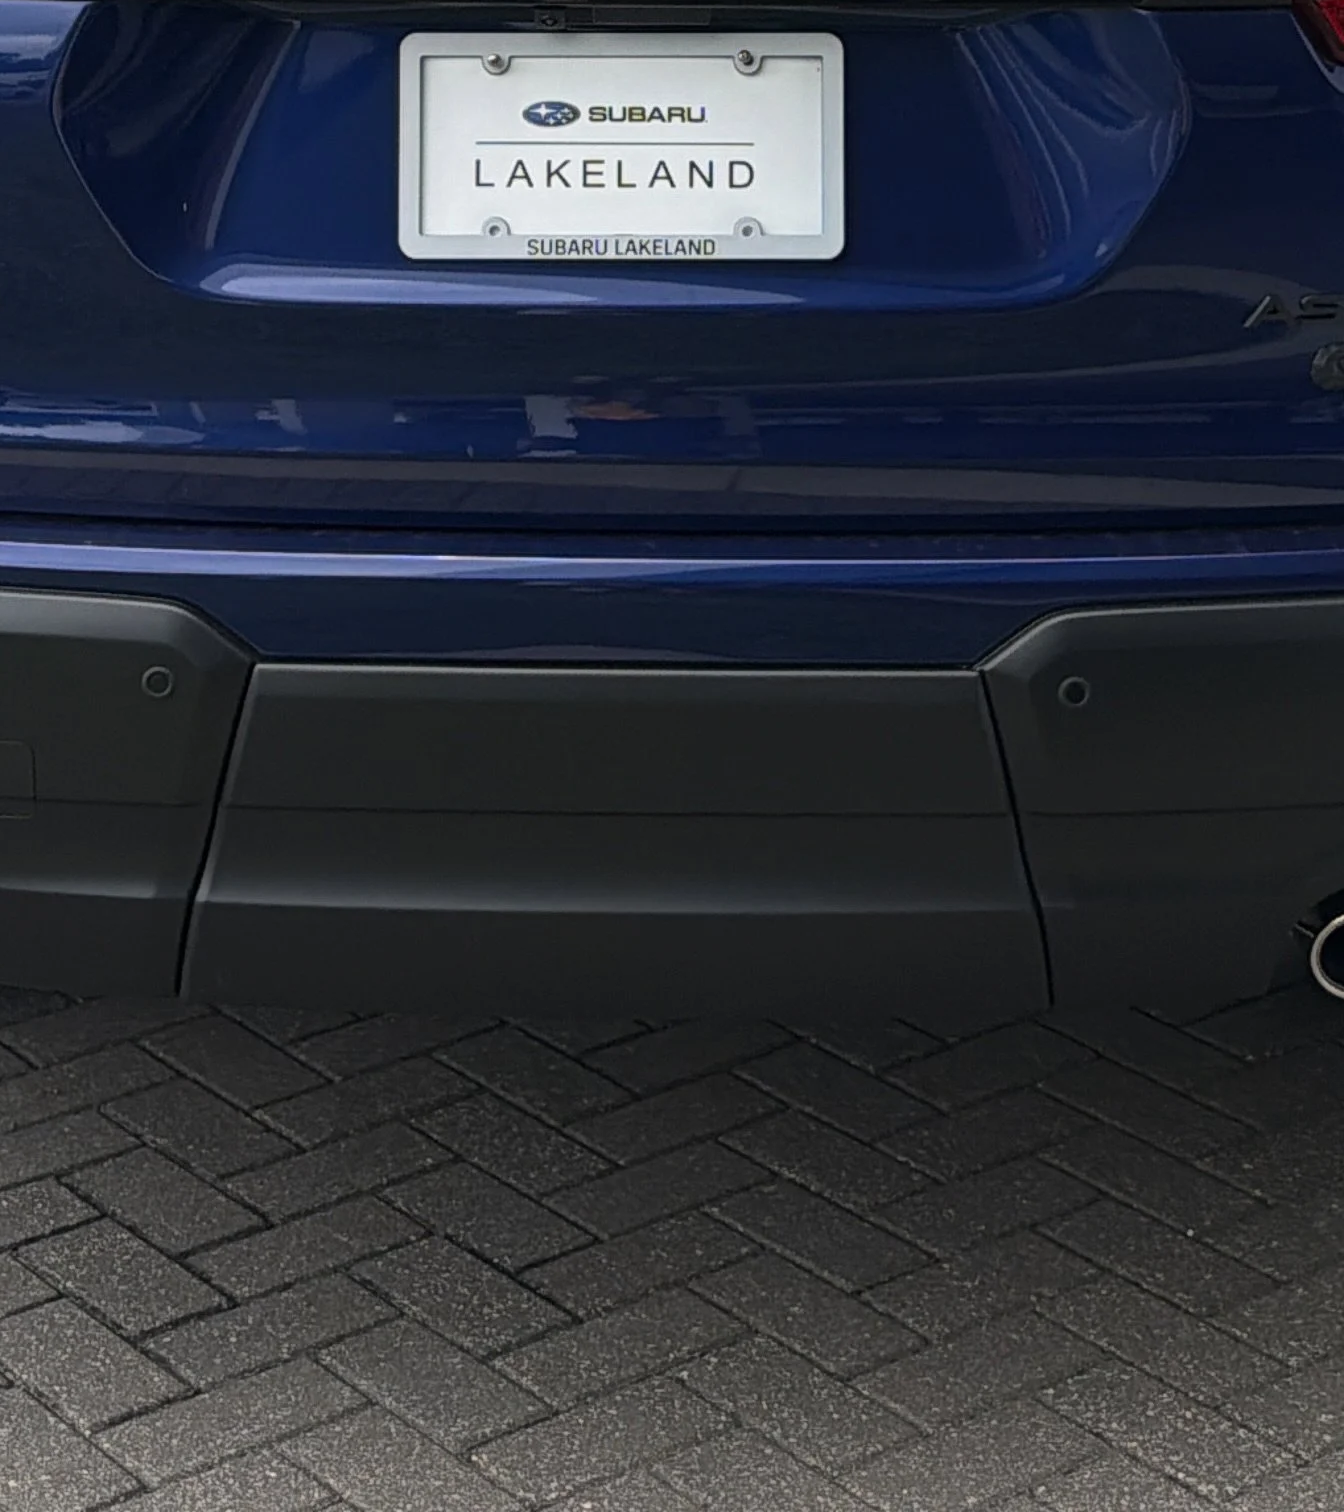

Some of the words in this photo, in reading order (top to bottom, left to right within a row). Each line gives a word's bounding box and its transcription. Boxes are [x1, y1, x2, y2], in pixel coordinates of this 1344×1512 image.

[588, 106, 708, 124] SUBARU
[474, 158, 755, 189] LAKELAND
[527, 239, 608, 256] SUBARU
[614, 239, 715, 256] LAKELAND
